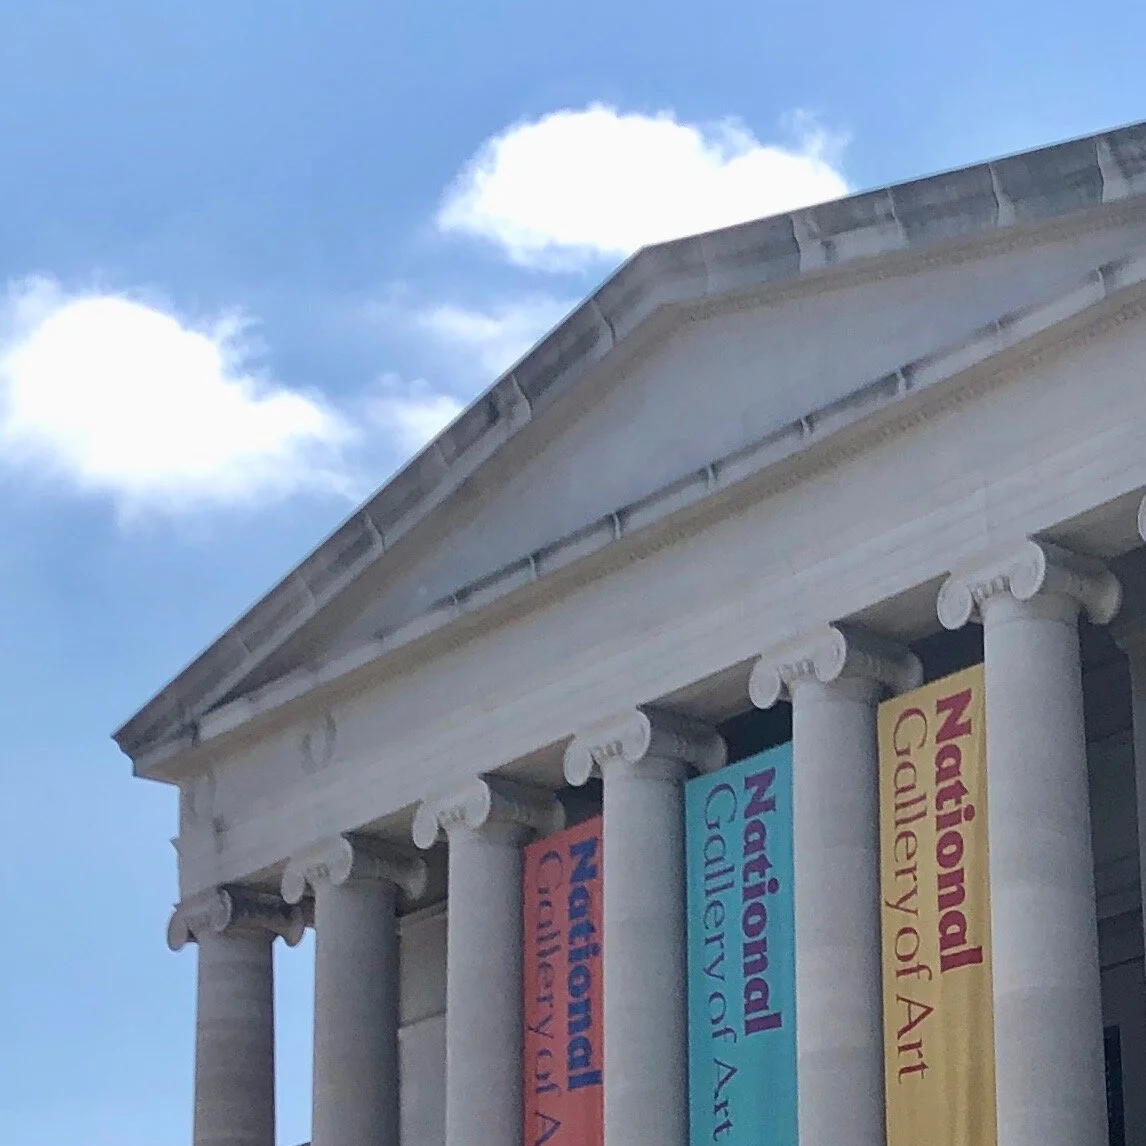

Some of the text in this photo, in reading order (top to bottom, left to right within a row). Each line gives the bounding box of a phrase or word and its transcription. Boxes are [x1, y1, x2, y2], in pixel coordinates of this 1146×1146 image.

[527, 851, 562, 1039] Gallery
[567, 836, 603, 1091] National
[702, 783, 738, 1142] Gallery of Art
[742, 767, 783, 1036] National
[885, 707, 934, 1084] Gallery of Art
[934, 688, 984, 974] National
[536, 1048, 563, 1097] of
